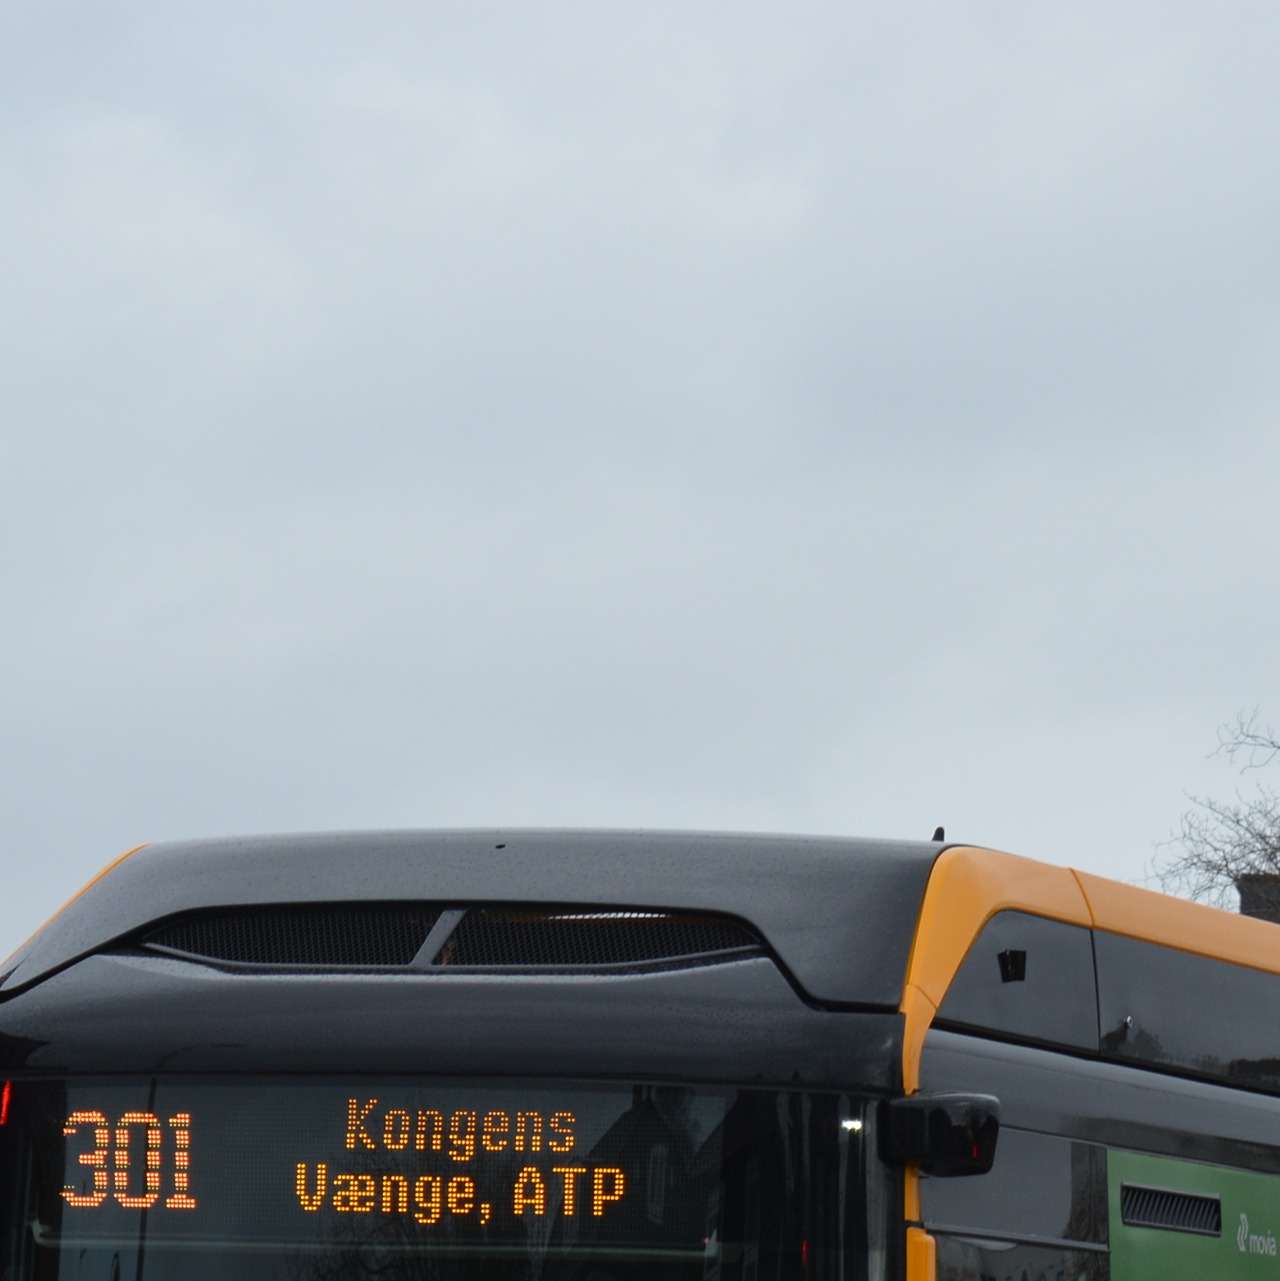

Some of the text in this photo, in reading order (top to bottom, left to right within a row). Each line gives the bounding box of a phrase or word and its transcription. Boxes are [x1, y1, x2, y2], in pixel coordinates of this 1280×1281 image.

[60, 1111, 196, 1208] 301
[346, 1098, 576, 1161] Kongens
[296, 1163, 624, 1224] Vænge, ATP
[1250, 1229, 1276, 1256] movia
